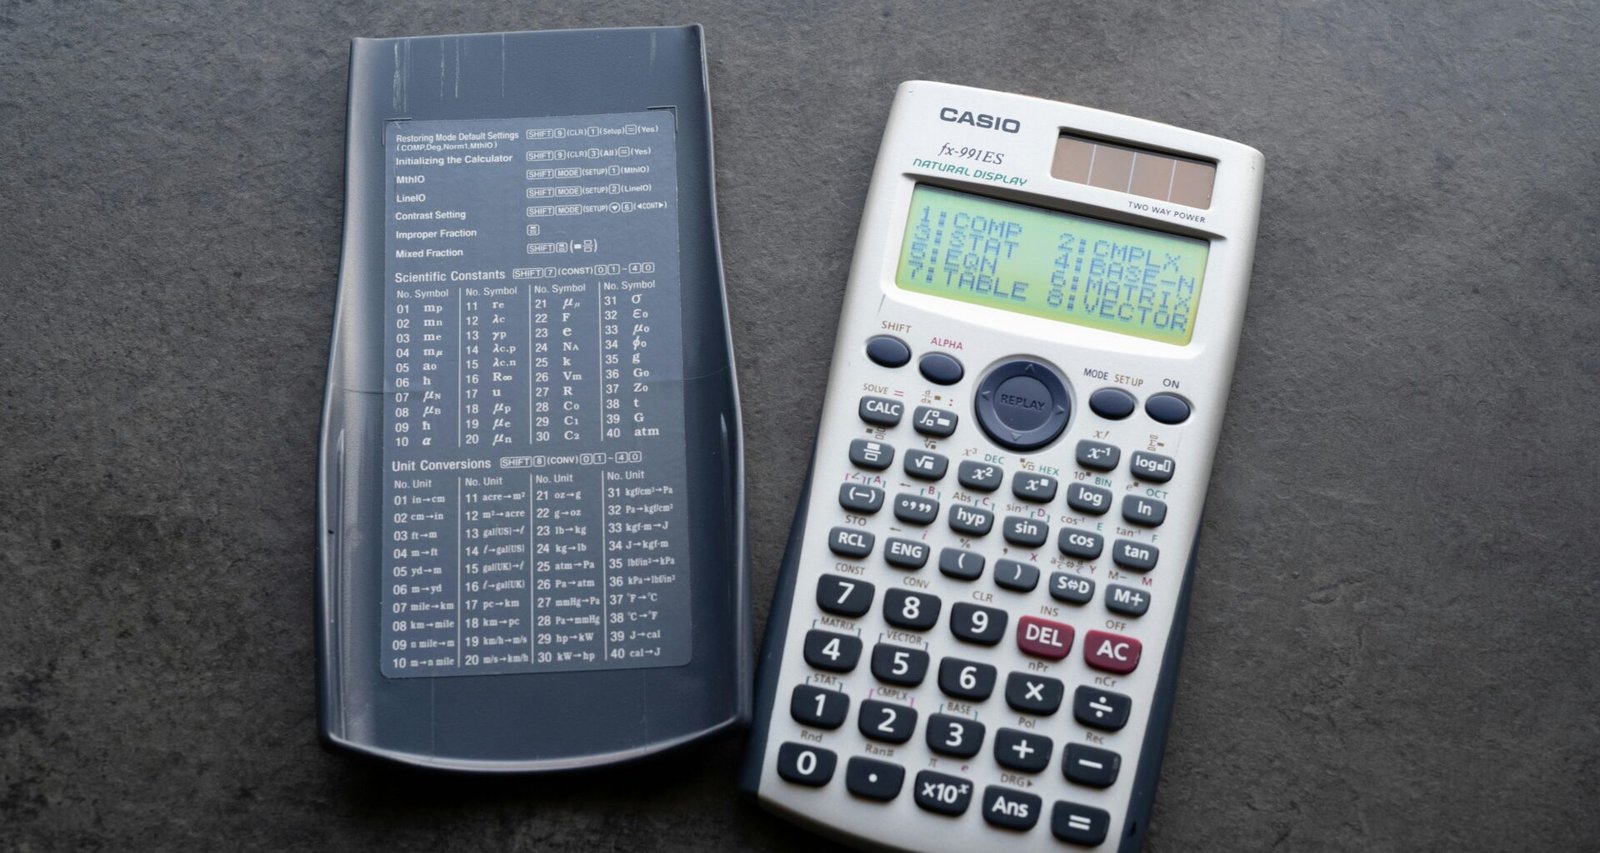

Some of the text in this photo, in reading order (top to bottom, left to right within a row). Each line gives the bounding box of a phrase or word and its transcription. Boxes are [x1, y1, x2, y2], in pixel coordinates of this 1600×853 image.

[940, 107, 1020, 133] CASIO
[396, 132, 519, 143] Restoring Mode Default Settings
[528, 130, 551, 138] SHIFT
[396, 154, 512, 166] Initializing the Calculator
[528, 152, 551, 160] SHIFT
[938, 143, 1004, 165] fx-991ES
[913, 158, 1028, 186] NATURAL DISPLAY
[396, 176, 424, 184] MthIO
[396, 194, 426, 202] LineIO
[396, 211, 466, 220] Contrast Setting
[1128, 201, 1206, 223] TWO WAY POWER
[396, 229, 476, 240] Improper Fraction
[396, 250, 426, 258] Mixed
[395, 270, 505, 282] Scientific Constants
[515, 270, 541, 278] SHIFT
[558, 267, 593, 276] (CONST)
[534, 284, 585, 294] No. Symbol
[604, 280, 655, 290] No. Symbol
[397, 289, 448, 299] No. Symbol
[466, 287, 517, 296] No. Symbol
[466, 302, 478, 310] 11
[536, 300, 547, 308] 21
[604, 296, 616, 305] 31
[397, 305, 409, 314] 01
[881, 321, 912, 333] SHIFT
[931, 337, 964, 350] ALPHA
[1084, 368, 1109, 380] MODE
[863, 384, 888, 394] SOLVE
[1163, 379, 1179, 388] ON
[1000, 393, 1045, 411] REPLAY
[867, 401, 900, 416] CALC
[606, 426, 659, 438] 40 atm
[392, 458, 491, 472] Unit Conversions
[502, 459, 530, 467] SHIFT
[547, 455, 578, 464] (CONV)
[985, 454, 1005, 465] DEC
[607, 471, 644, 480] No. Unit
[1039, 465, 1060, 476] HEX
[394, 479, 432, 488] No. Unit
[465, 477, 502, 486] No. Unit
[536, 474, 573, 483] No. Unit
[1095, 477, 1112, 487] BIN
[952, 492, 972, 502] Abs
[1079, 488, 1102, 506] log
[1146, 488, 1168, 499] OCT
[1138, 502, 1152, 516] ln
[845, 515, 867, 526] STO
[957, 508, 985, 526] hyp
[1015, 521, 1037, 535] sin
[838, 532, 866, 547] RCL
[1069, 534, 1094, 548] cos
[891, 543, 922, 558] ENG
[1124, 545, 1149, 560] tan
[835, 562, 865, 575] CONST
[903, 576, 929, 589] CONV
[837, 583, 854, 604] 7
[972, 591, 993, 602] CLR
[1115, 589, 1143, 606] M+
[393, 603, 407, 613] 07
[902, 597, 920, 619] 8
[1041, 606, 1059, 617] INS
[392, 621, 406, 631] 08
[821, 617, 855, 630] MATRIX
[971, 611, 988, 633] 9
[1106, 620, 1127, 631] OFF
[886, 630, 923, 644] VECTOR
[1026, 624, 1063, 647] DEL
[611, 649, 625, 659] 40
[822, 639, 840, 660] 4
[1097, 640, 1129, 661] AC
[393, 658, 406, 668] 10
[466, 655, 479, 665] 20
[538, 652, 551, 662] 30
[892, 653, 910, 674] 5
[1028, 661, 1048, 672] nPr
[813, 674, 837, 685] STAT
[959, 667, 977, 689] 6
[1095, 676, 1116, 687] nCr
[877, 687, 908, 700] CMPLX
[815, 694, 826, 716] 1
[947, 703, 972, 714] BASE
[878, 708, 897, 732] 2
[1019, 717, 1035, 728] Pol
[801, 730, 823, 743] Rnd
[945, 723, 964, 746] 3
[1086, 732, 1104, 744] Rec
[865, 744, 895, 757] Ran#
[797, 751, 817, 775] 0
[992, 796, 1029, 817] Ans
